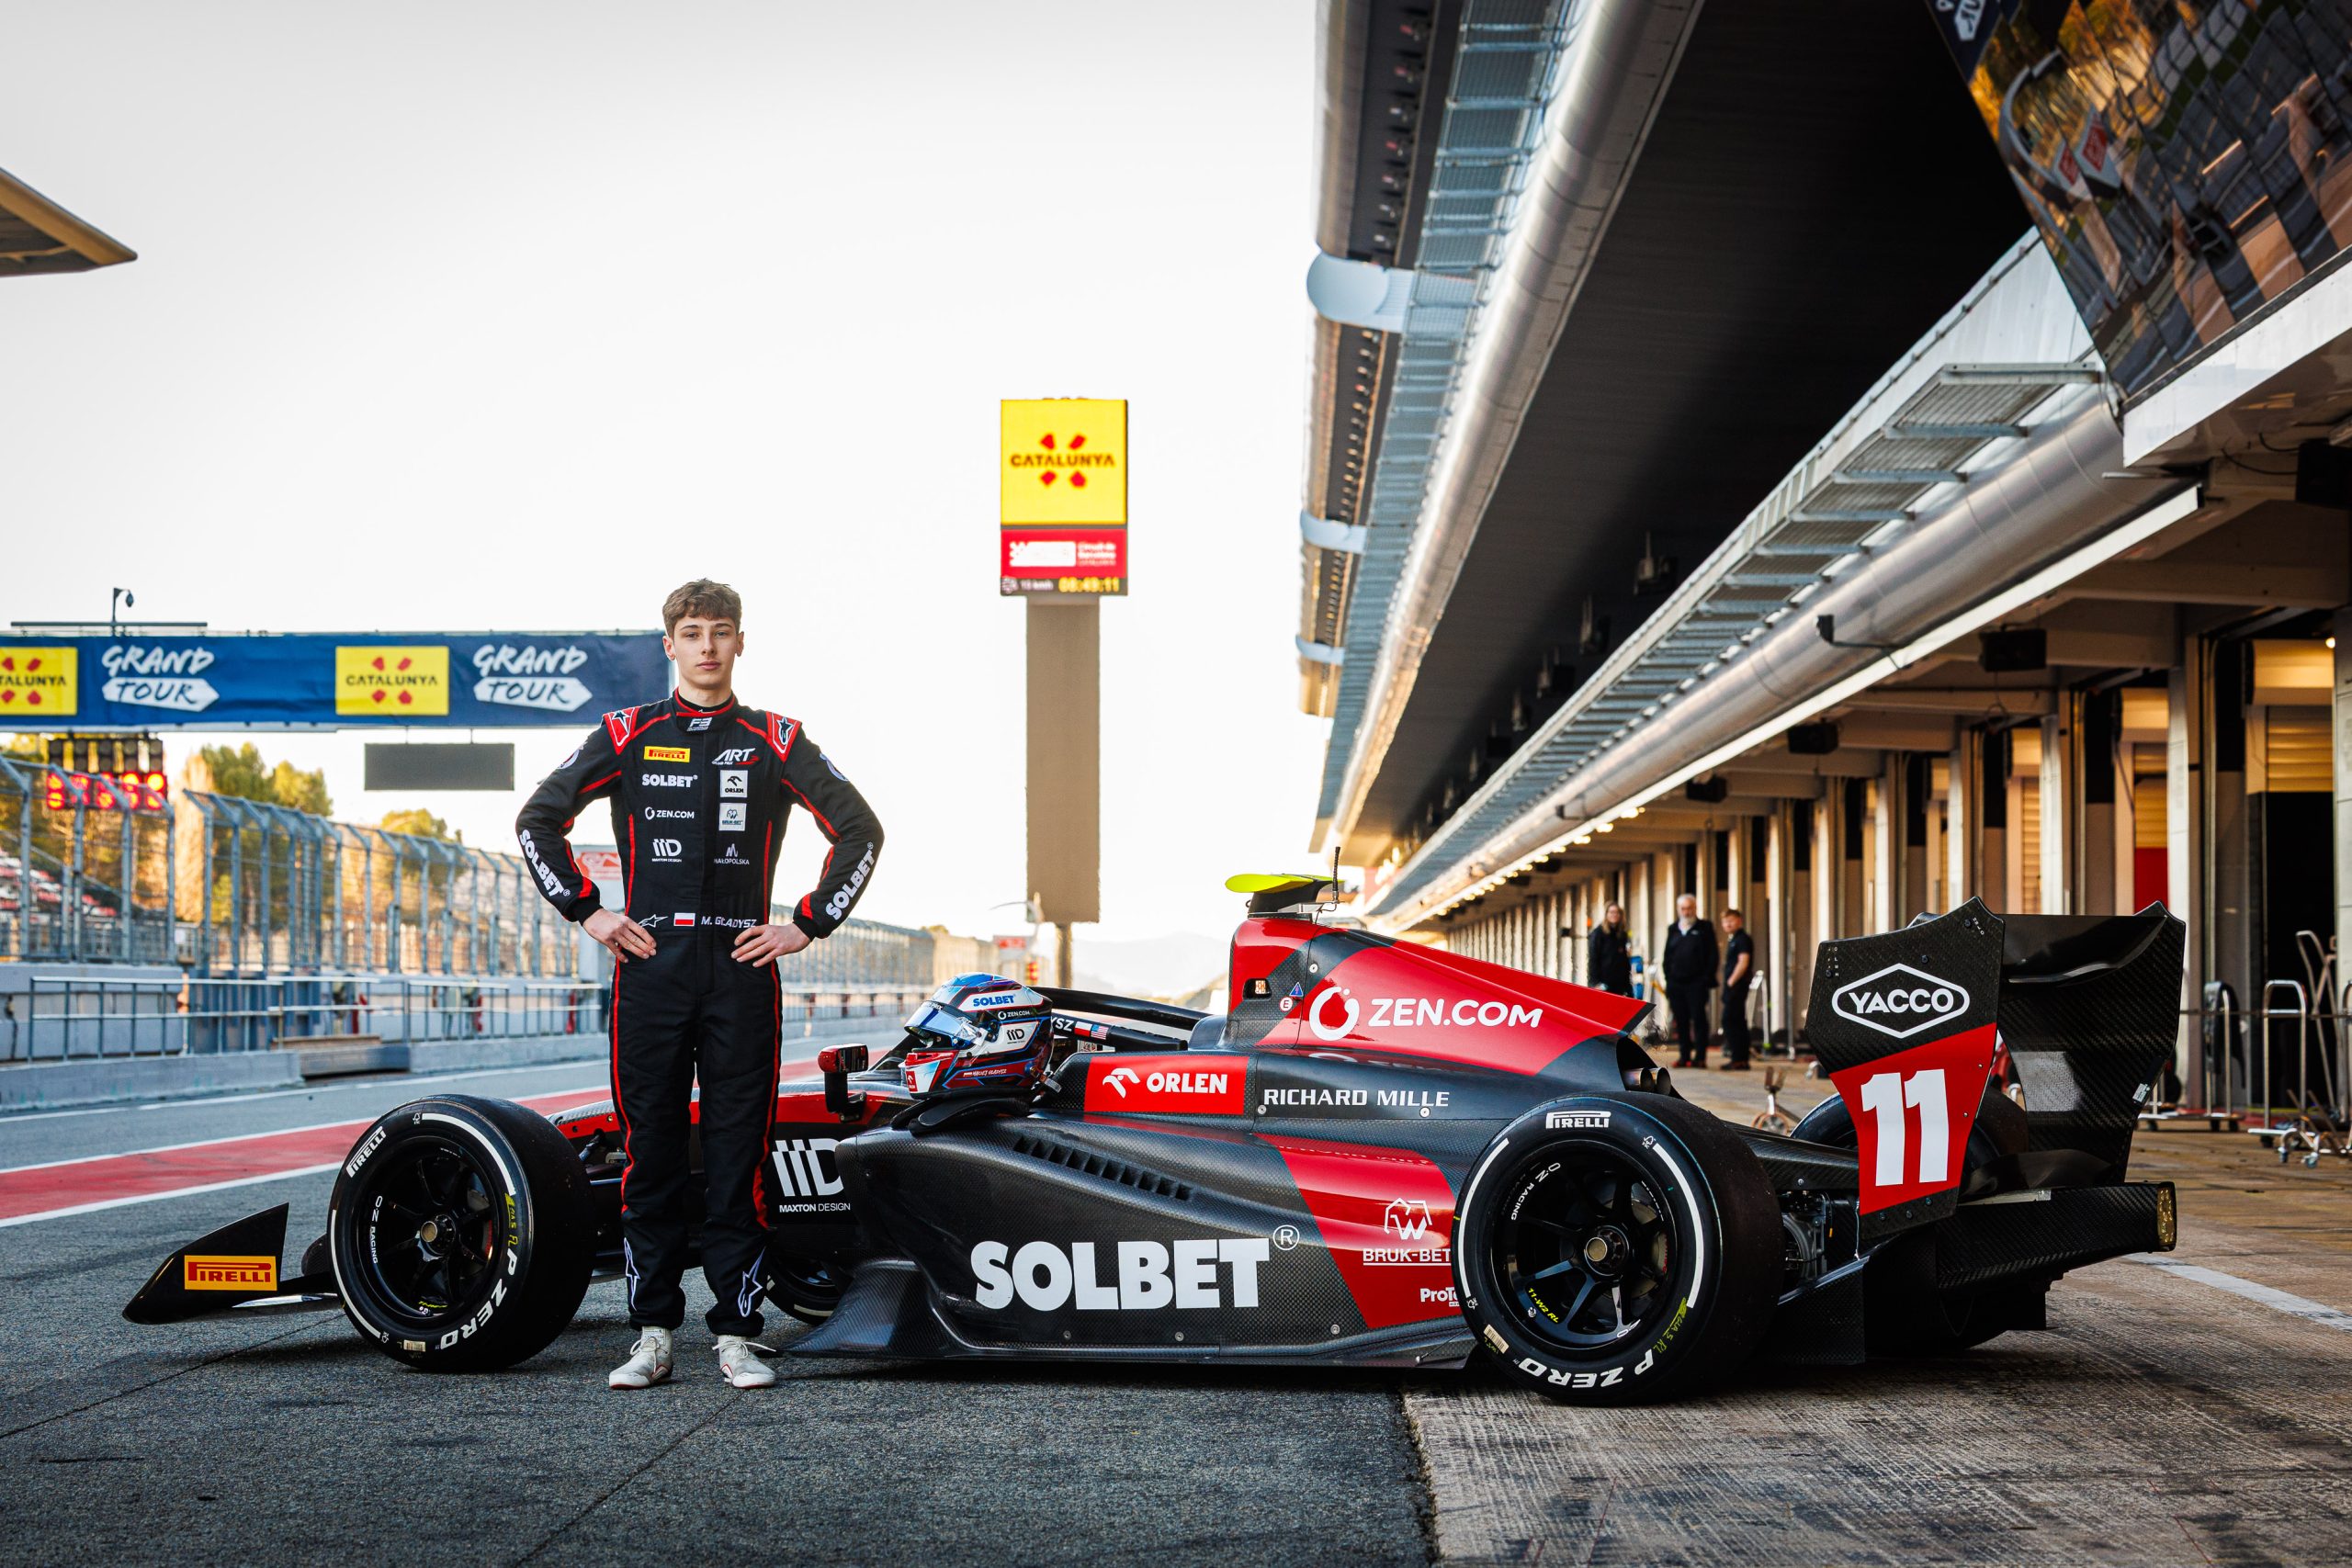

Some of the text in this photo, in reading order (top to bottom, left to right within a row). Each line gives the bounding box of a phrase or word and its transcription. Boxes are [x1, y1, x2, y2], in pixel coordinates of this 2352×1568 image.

[1011, 453, 1115, 468] CATALUNYA
[102, 645, 214, 677] GRAND
[473, 644, 588, 677] GRAND
[345, 674, 438, 686] CATALUNYA
[118, 682, 197, 705] TOUR
[488, 681, 570, 705] TOUR
[648, 749, 686, 760] PIRELLI
[712, 748, 756, 762] ART
[656, 809, 695, 819] ZEN.COM
[700, 916, 713, 925] M.
[1849, 988, 1954, 1013] YACCO
[1367, 998, 1544, 1028] ZEN.COM
[1147, 1072, 1227, 1094] ORLEN
[1263, 1089, 1450, 1108] RICHARD MILLE
[1546, 1111, 1611, 1129] PIRELLI
[1861, 1068, 1950, 1187] 11
[345, 1126, 387, 1178] PIRELLI
[779, 1202, 851, 1213] MAXTON DESIGN
[1511, 1182, 1534, 1220] RACING
[369, 1226, 379, 1264] RACING
[1363, 1247, 1452, 1262] BRUK-BET
[187, 1262, 271, 1283] PIRELLI
[440, 1247, 518, 1350] P ZERO
[1547, 1311, 1560, 1324] RL
[1518, 1348, 1654, 1389] P ZERO
